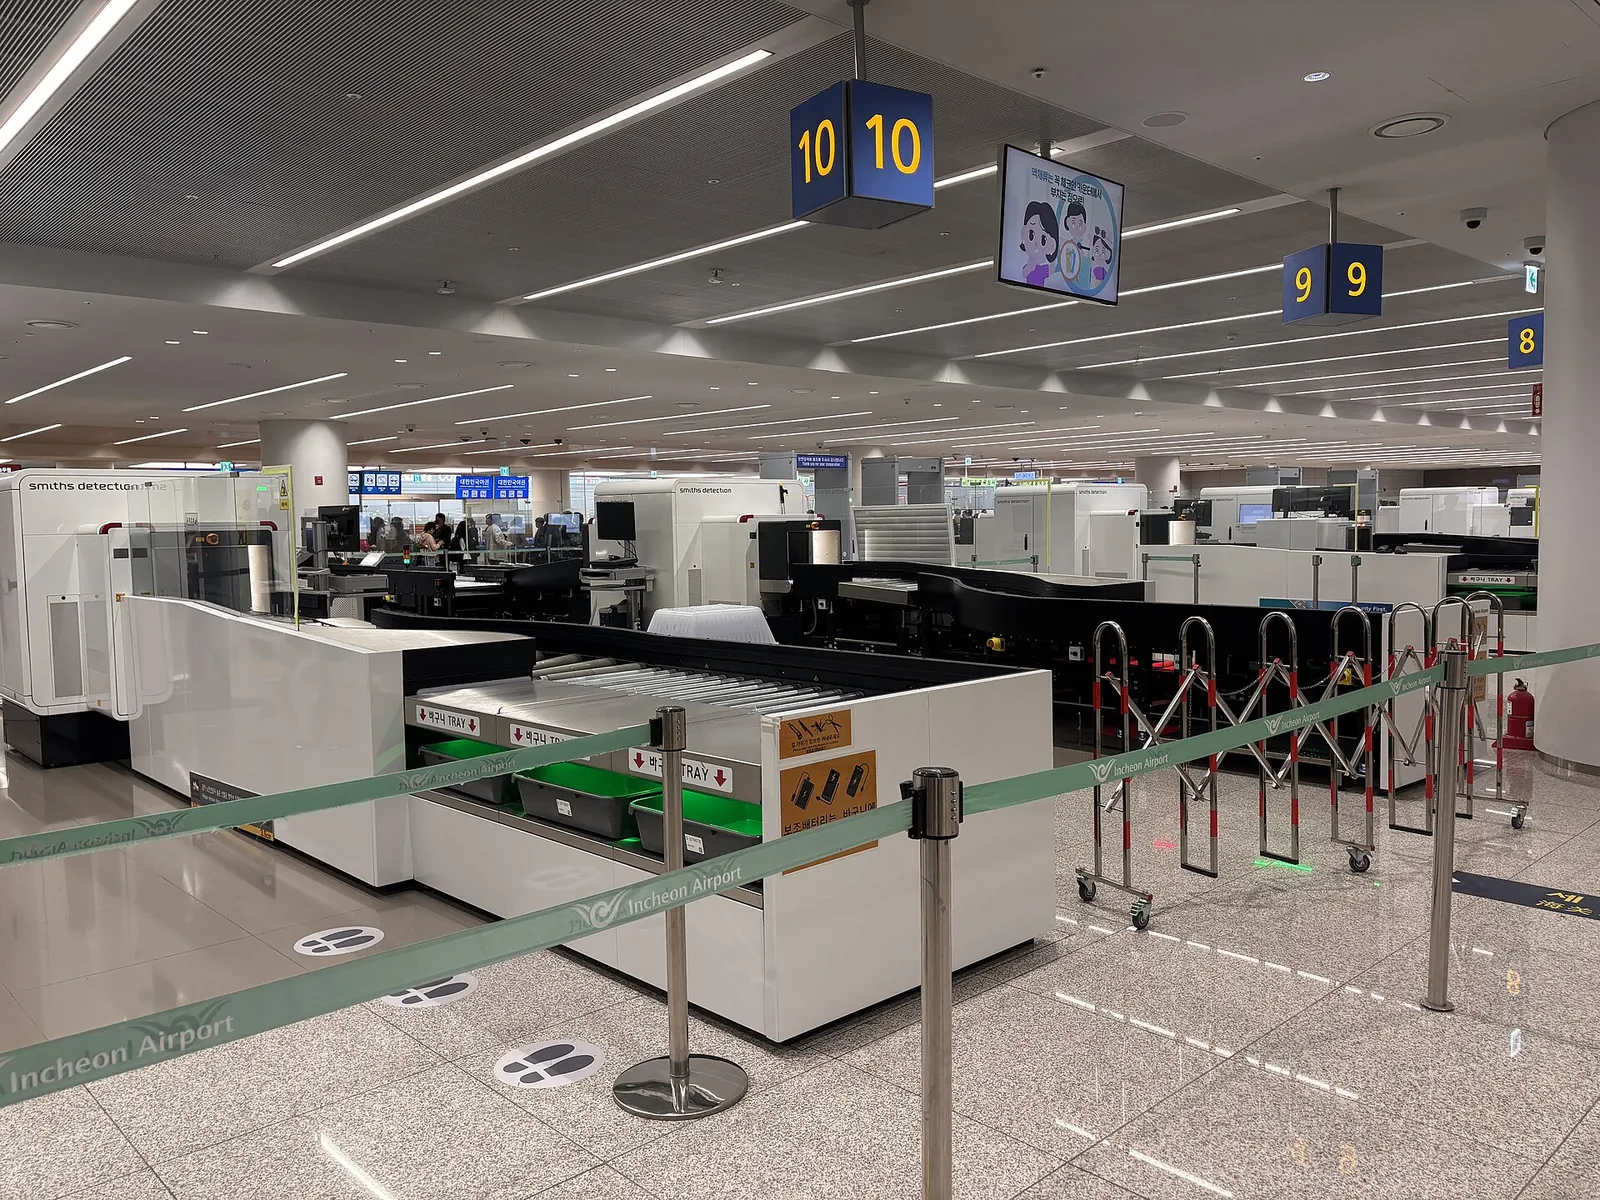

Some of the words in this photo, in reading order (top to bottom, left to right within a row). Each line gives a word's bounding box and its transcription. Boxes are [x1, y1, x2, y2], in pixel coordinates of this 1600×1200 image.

[798, 119, 836, 184] 10
[865, 114, 921, 174] 10
[1296, 267, 1312, 302] 9
[1347, 262, 1366, 297] 9
[1520, 328, 1534, 354] 8
[29, 482, 74, 490] smiths
[78, 482, 139, 490] detection
[448, 715, 466, 729] TRAY
[1282, 717, 1301, 729] Incheon
[1302, 711, 1320, 725] Airport
[480, 760, 516, 774] Airport
[681, 764, 709, 781] TRAY
[1114, 762, 1142, 776] Incheon
[1144, 754, 1168, 768] Airport
[628, 884, 688, 916] Incheon
[692, 866, 742, 894] Airport
[10, 1046, 127, 1093] Incheon
[138, 1015, 234, 1058] Airport
